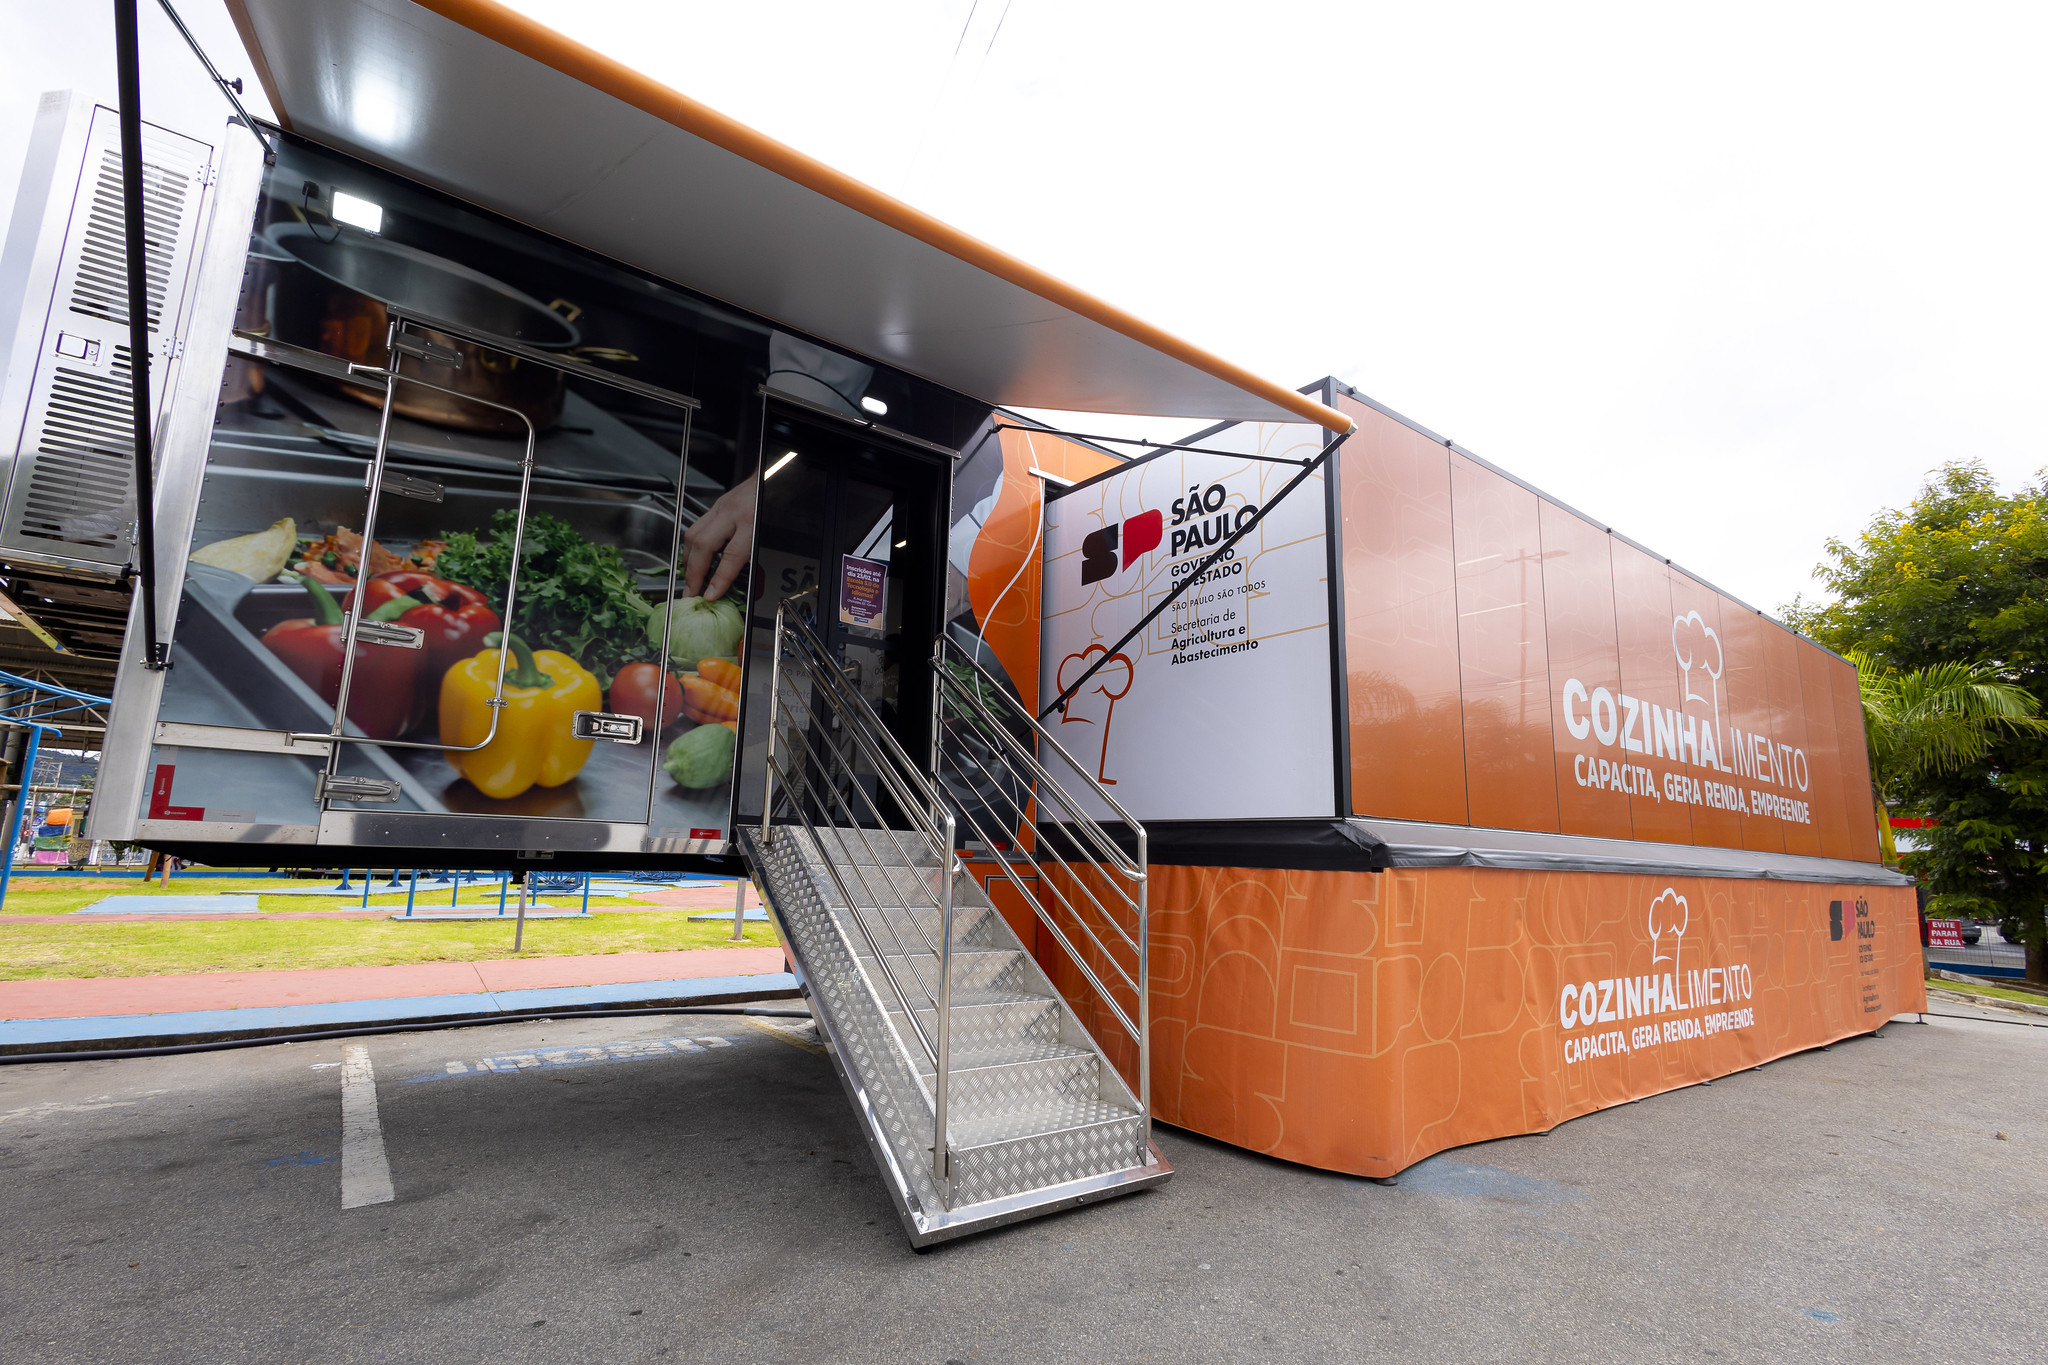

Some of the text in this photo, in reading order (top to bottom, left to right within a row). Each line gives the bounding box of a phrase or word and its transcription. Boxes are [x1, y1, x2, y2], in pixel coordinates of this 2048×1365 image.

[1170, 484, 1226, 526] SÃO
[1171, 504, 1260, 557] PAULO
[1171, 548, 1235, 577] GOVENO
[1171, 580, 1266, 612] SÃO PAULO SÃO TODOS
[1171, 607, 1236, 634] Secretaria de
[1171, 625, 1246, 651] Agricultura e
[1171, 639, 1259, 666] Abastecimento
[1563, 678, 1809, 792] COZINHALIMENTO
[1574, 754, 1811, 824] CAPACITA, GERA RENDA, EMPREENDE
[1931, 930, 1959, 938] PARAR
[1932, 921, 1956, 929] EVITE
[1930, 938, 1943, 946] NA
[1560, 957, 1752, 1030] COZINHALIMENTO
[1564, 1007, 1755, 1064] CAPACITA, GERA RENDA, EMPREENDE
